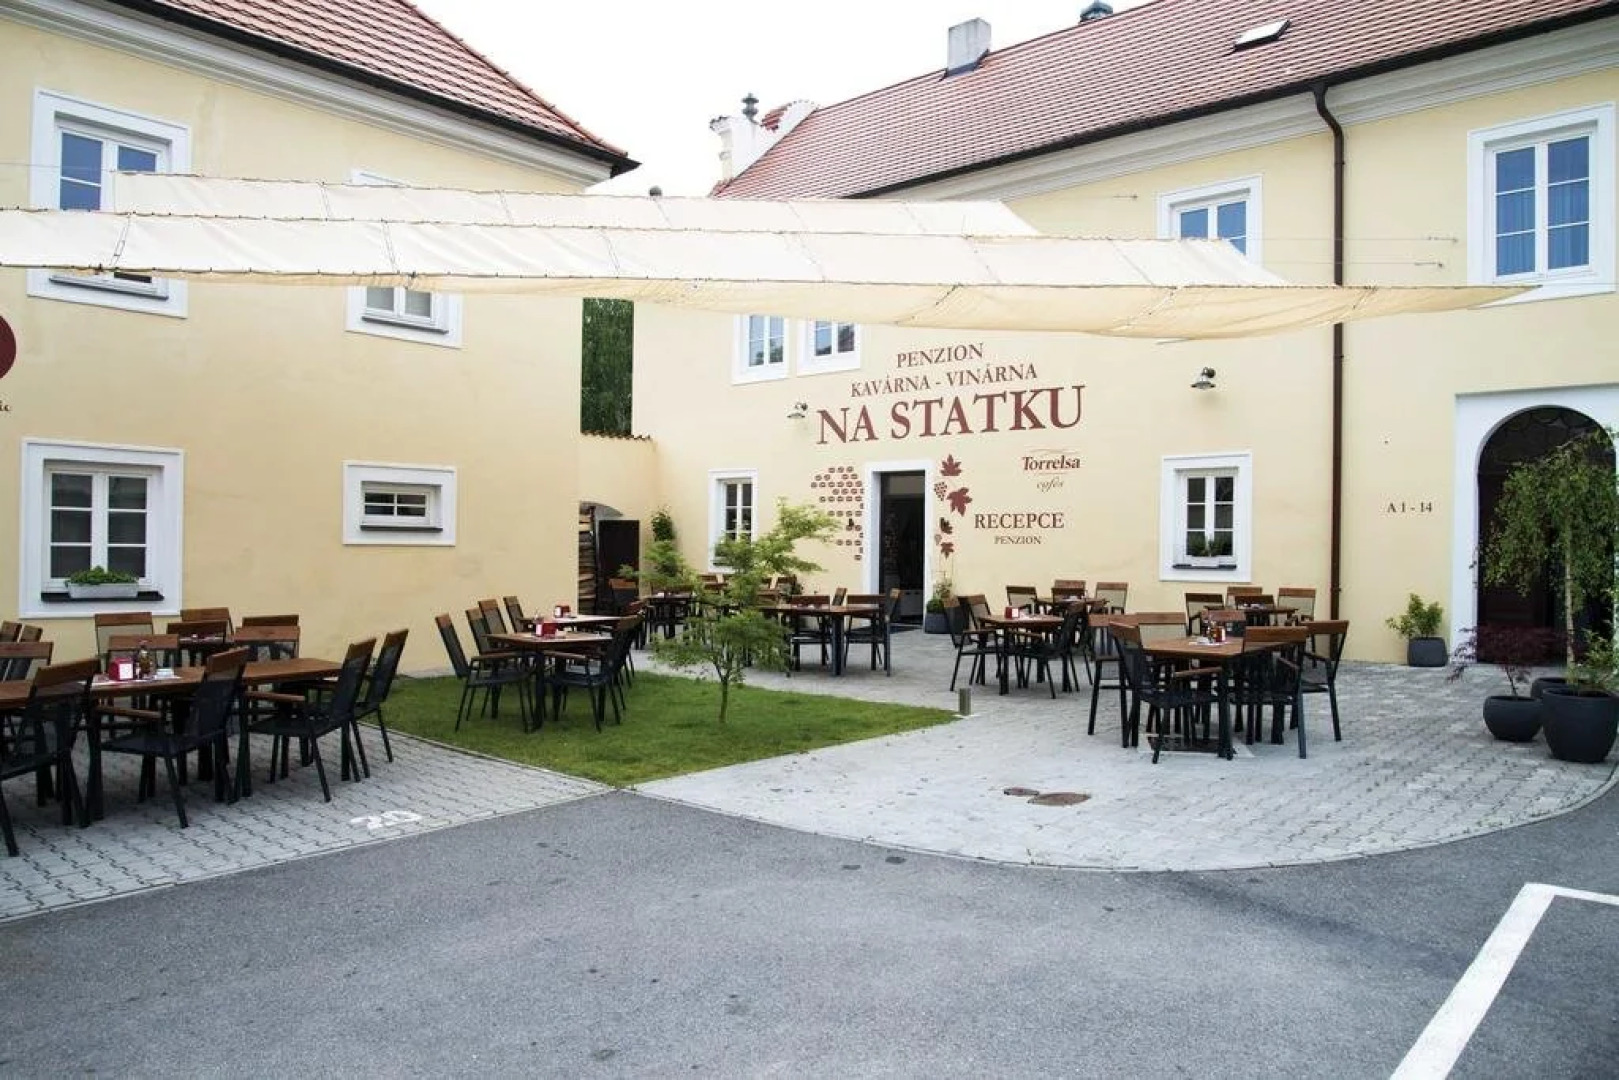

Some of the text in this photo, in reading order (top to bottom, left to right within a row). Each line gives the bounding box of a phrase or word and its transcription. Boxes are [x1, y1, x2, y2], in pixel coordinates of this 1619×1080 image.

[897, 342, 984, 368] PENZION
[851, 374, 931, 397] KAVÁRNA
[946, 363, 1038, 386] VINÁRNA
[816, 385, 1087, 444] NA STATKU
[1021, 455, 1081, 471] Torrelsa
[1387, 501, 1397, 513] A
[1420, 501, 1433, 513] 14
[974, 512, 1065, 530] RECEPCE
[994, 535, 1042, 545] PENZION
